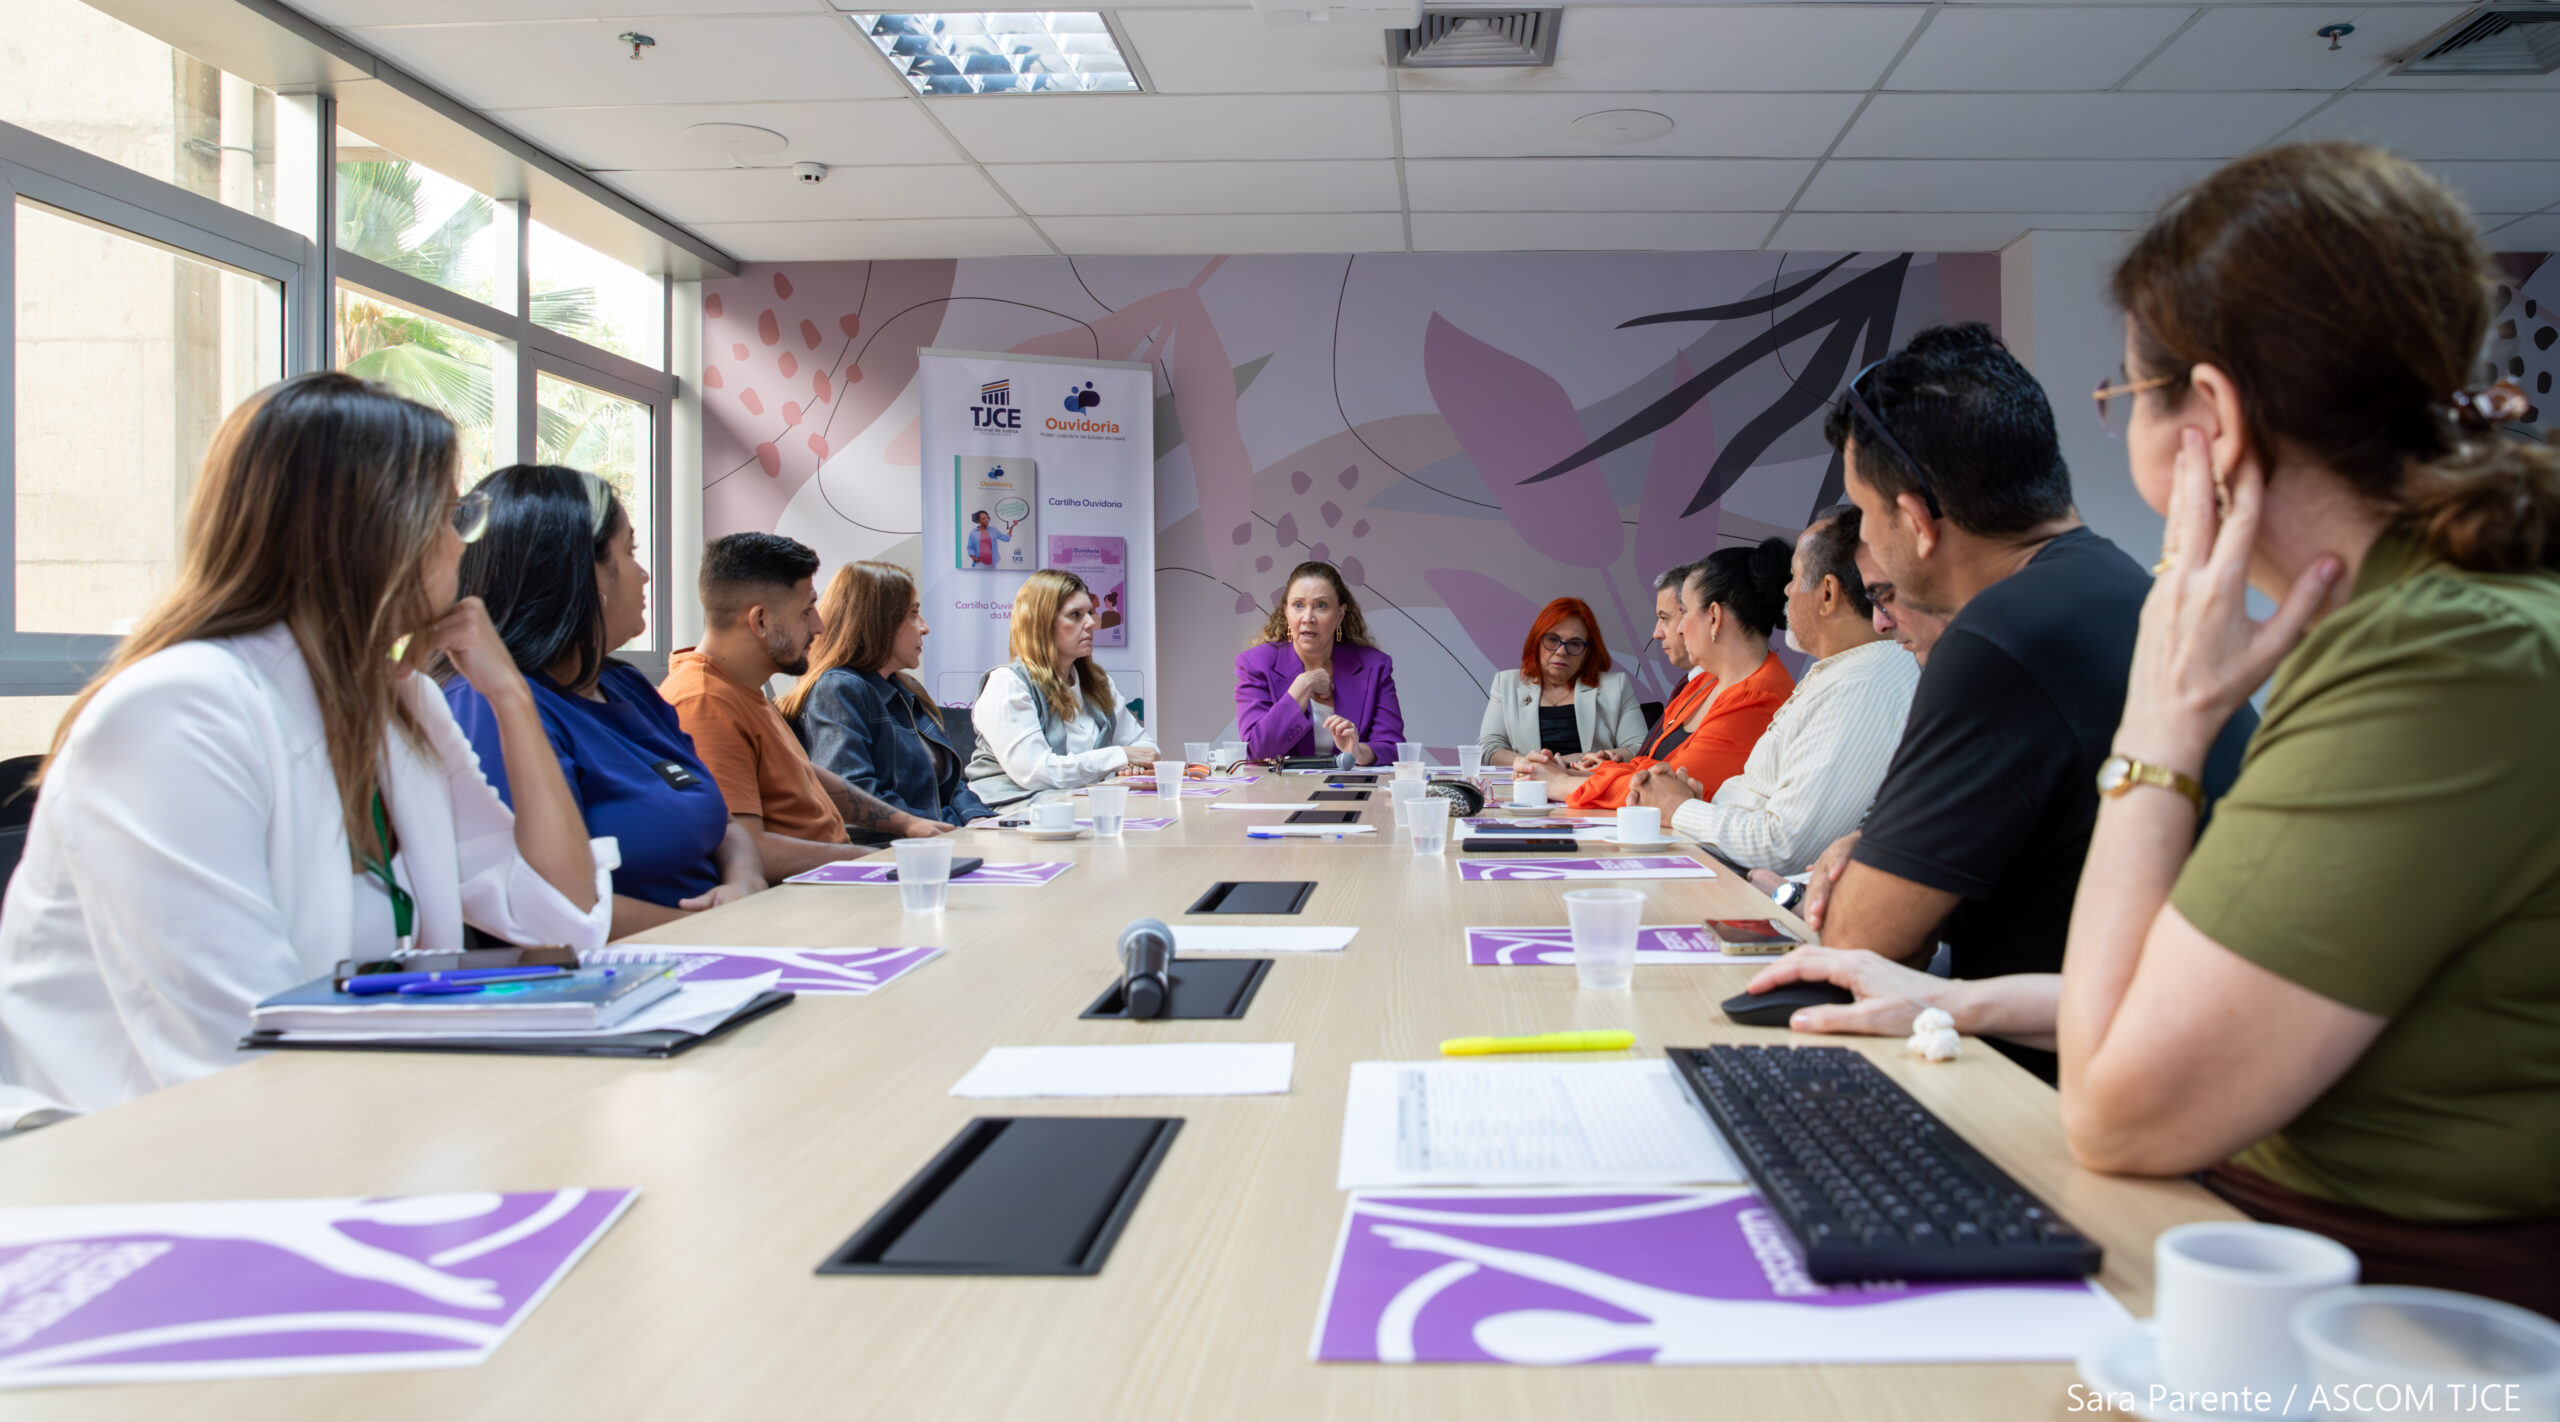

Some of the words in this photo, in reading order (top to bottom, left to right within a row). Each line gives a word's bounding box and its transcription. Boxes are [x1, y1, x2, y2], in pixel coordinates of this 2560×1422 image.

[970, 406, 1021, 428] TJCE
[1045, 417, 1120, 433] Ouvidoria
[979, 480, 1013, 488] Ouvidoria
[1048, 497, 1081, 507] Cartilha
[1082, 498, 1122, 508] Ouvidoria
[955, 601, 989, 610] Cartilha
